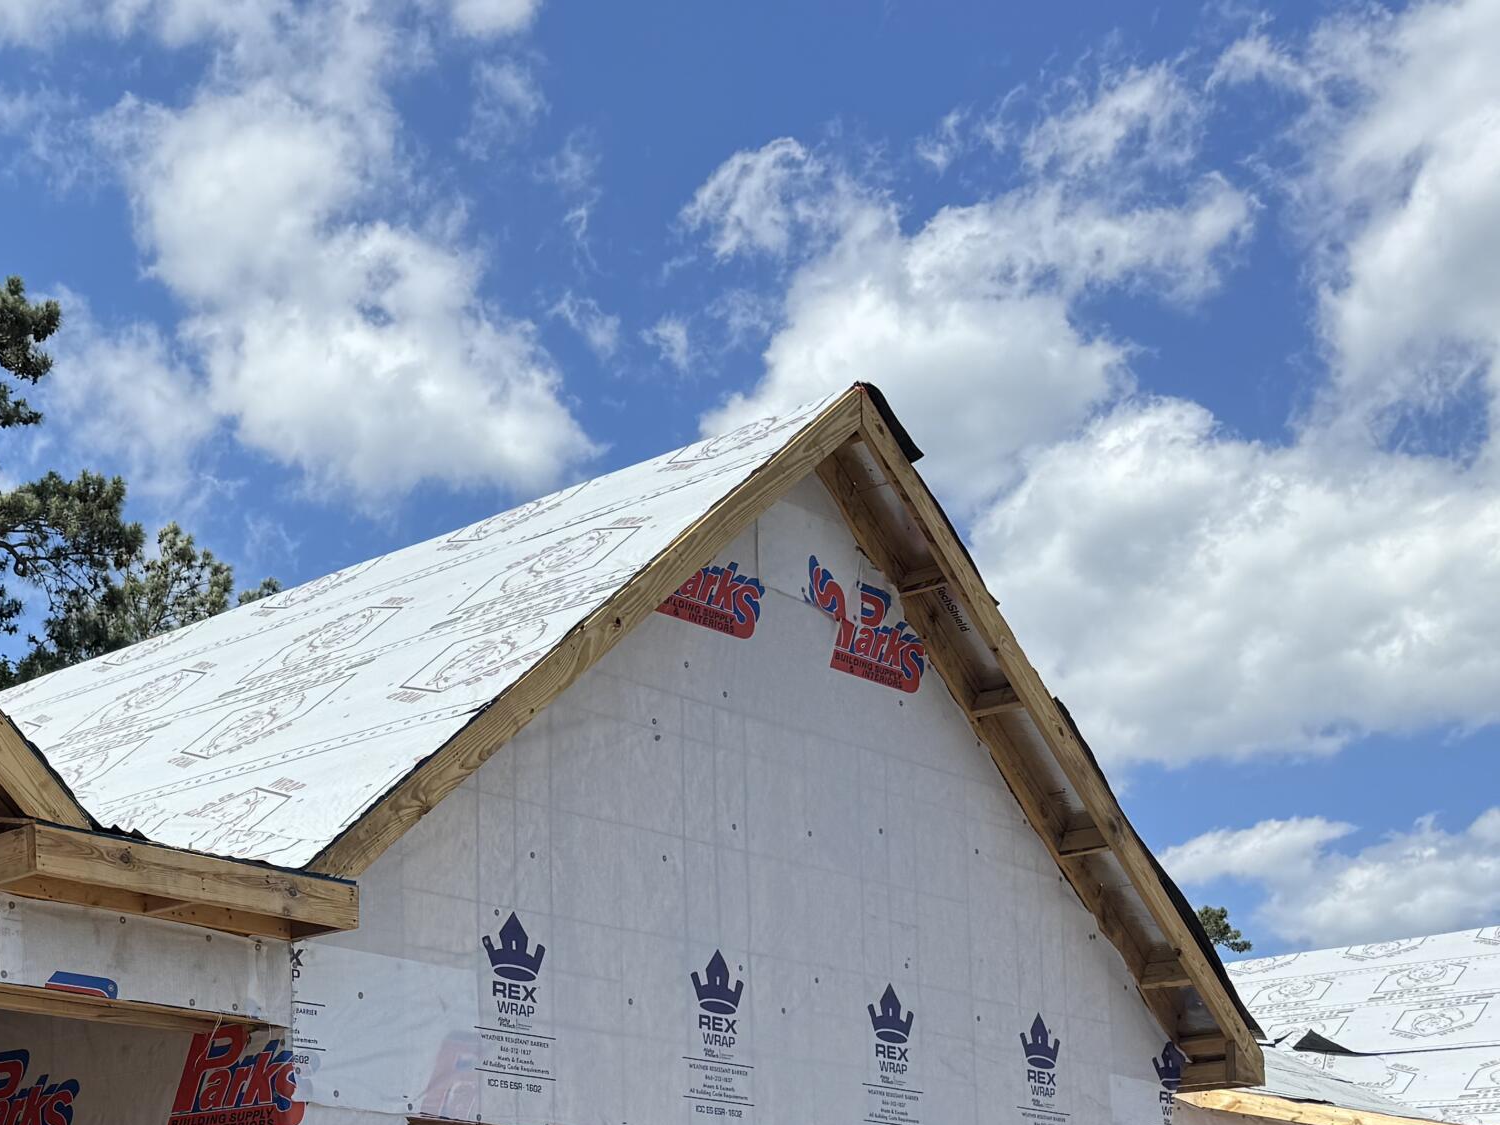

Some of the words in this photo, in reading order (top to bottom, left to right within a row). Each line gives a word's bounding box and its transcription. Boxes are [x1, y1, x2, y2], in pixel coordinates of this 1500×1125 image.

[679, 562, 765, 624] arks
[689, 612, 734, 633] INTERIORS
[703, 607, 734, 624] SUPPLY
[835, 652, 872, 671] BUILDING
[874, 665, 903, 680] SUPPLY
[862, 671, 903, 689] INTERIORS
[493, 981, 537, 1003] REX
[497, 1000, 534, 1017] WRAP
[699, 1014, 737, 1034] REX
[505, 1038, 529, 1046] RESISTANT
[703, 1032, 735, 1048] WRAP
[876, 1044, 908, 1062] REX
[172, 1023, 297, 1112] Parks
[879, 1061, 907, 1074] WRAP
[488, 1079, 498, 1087] ICC
[1028, 1070, 1056, 1086] REX
[1031, 1085, 1055, 1097] WRAP
[228, 1108, 274, 1123] SUPPLY
